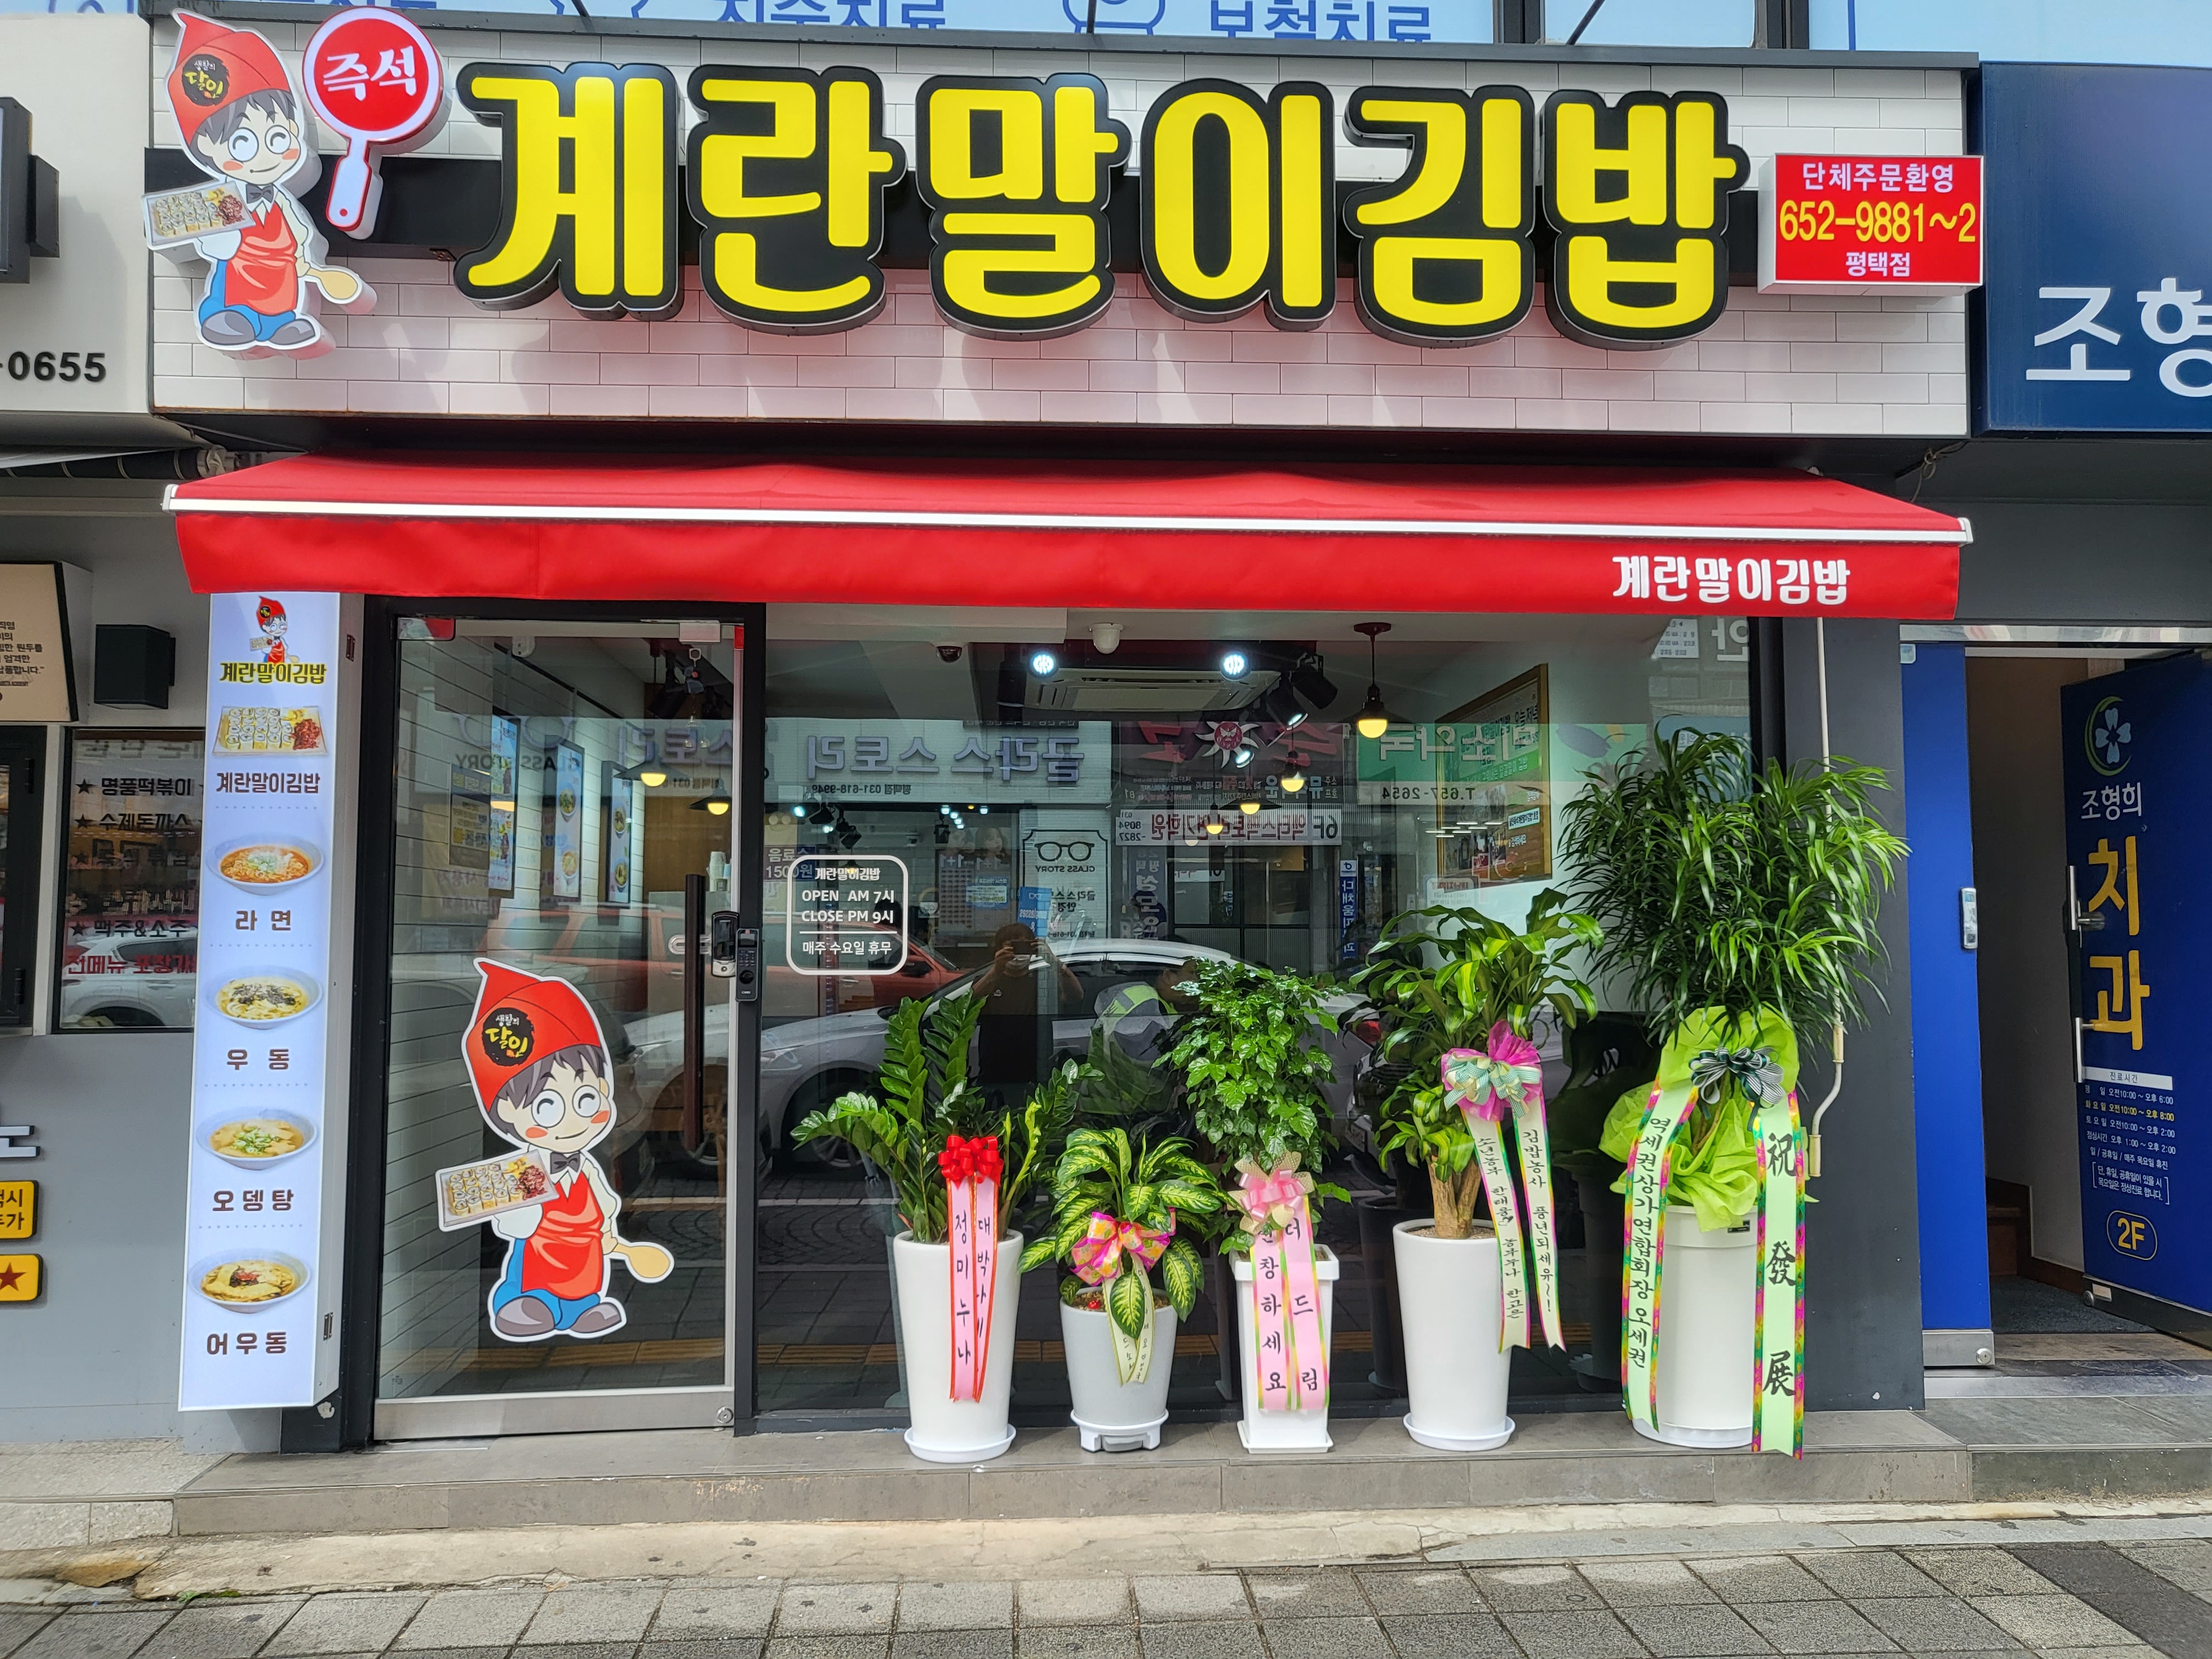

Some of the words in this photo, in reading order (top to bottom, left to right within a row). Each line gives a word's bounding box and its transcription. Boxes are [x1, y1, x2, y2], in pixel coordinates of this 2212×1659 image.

[194, 60, 216, 77] 생활의
[322, 46, 416, 101] 즉석
[184, 71, 223, 100] 달인
[1802, 162, 1955, 193] 단체주문환영
[468, 77, 1736, 327] 계란말이김밥
[1779, 199, 1977, 242] 652-9881~2
[1845, 252, 1911, 278] 평택점
[1612, 555, 1850, 606] 계란말이김밥
[220, 662, 327, 684] 계란말이김밥
[216, 772, 320, 795] 계란말이김밥
[2081, 781, 2143, 822] 조형희
[99, 813, 190, 831] 수제돈까스
[802, 890, 839, 901] OPEN
[848, 890, 869, 901] AM
[873, 890, 895, 904] 7시
[802, 910, 843, 922] CLOSE
[848, 910, 868, 922] PM
[872, 910, 894, 924] 9시
[802, 941, 827, 955] 매주
[830, 941, 865, 955] 수요일
[868, 941, 893, 955] 휴무
[2087, 834, 2152, 1053] 치과
[495, 1014, 520, 1027] 생활의
[485, 1026, 528, 1058] 달인
[2110, 1071, 2138, 1084] 진료시간
[2145, 1093, 2157, 1102] 오후
[2159, 1095, 2174, 1105] 6:00
[2146, 1109, 2158, 1119] 오후
[2159, 1111, 2174, 1122] 8:00
[2087, 1131, 2107, 1142] 점심시간
[2111, 1135, 2122, 1144] 오후
[2125, 1138, 2139, 1148] 1:00
[2147, 1141, 2160, 1152] 오후
[2161, 1144, 2176, 1155] 2:00
[2147, 1125, 2159, 1135] 오후
[2161, 1128, 2176, 1138] 2:00
[1522, 1129, 1546, 1188] 김밥농사
[2124, 1153, 2136, 1164] 매주
[2137, 1156, 2155, 1167] 목요일
[2156, 1159, 2169, 1170] 휴진
[2098, 1177, 2120, 1190] 목요일은
[2120, 1182, 2143, 1196] 정상진료
[2144, 1188, 2163, 1201] 합니다.
[2119, 1170, 2142, 1183] 공휴일이
[2143, 1175, 2155, 1186] 있을
[212, 1189, 294, 1212] 오뎅탕
[2116, 1217, 2146, 1251] 2F
[207, 1331, 287, 1355] 어우동
